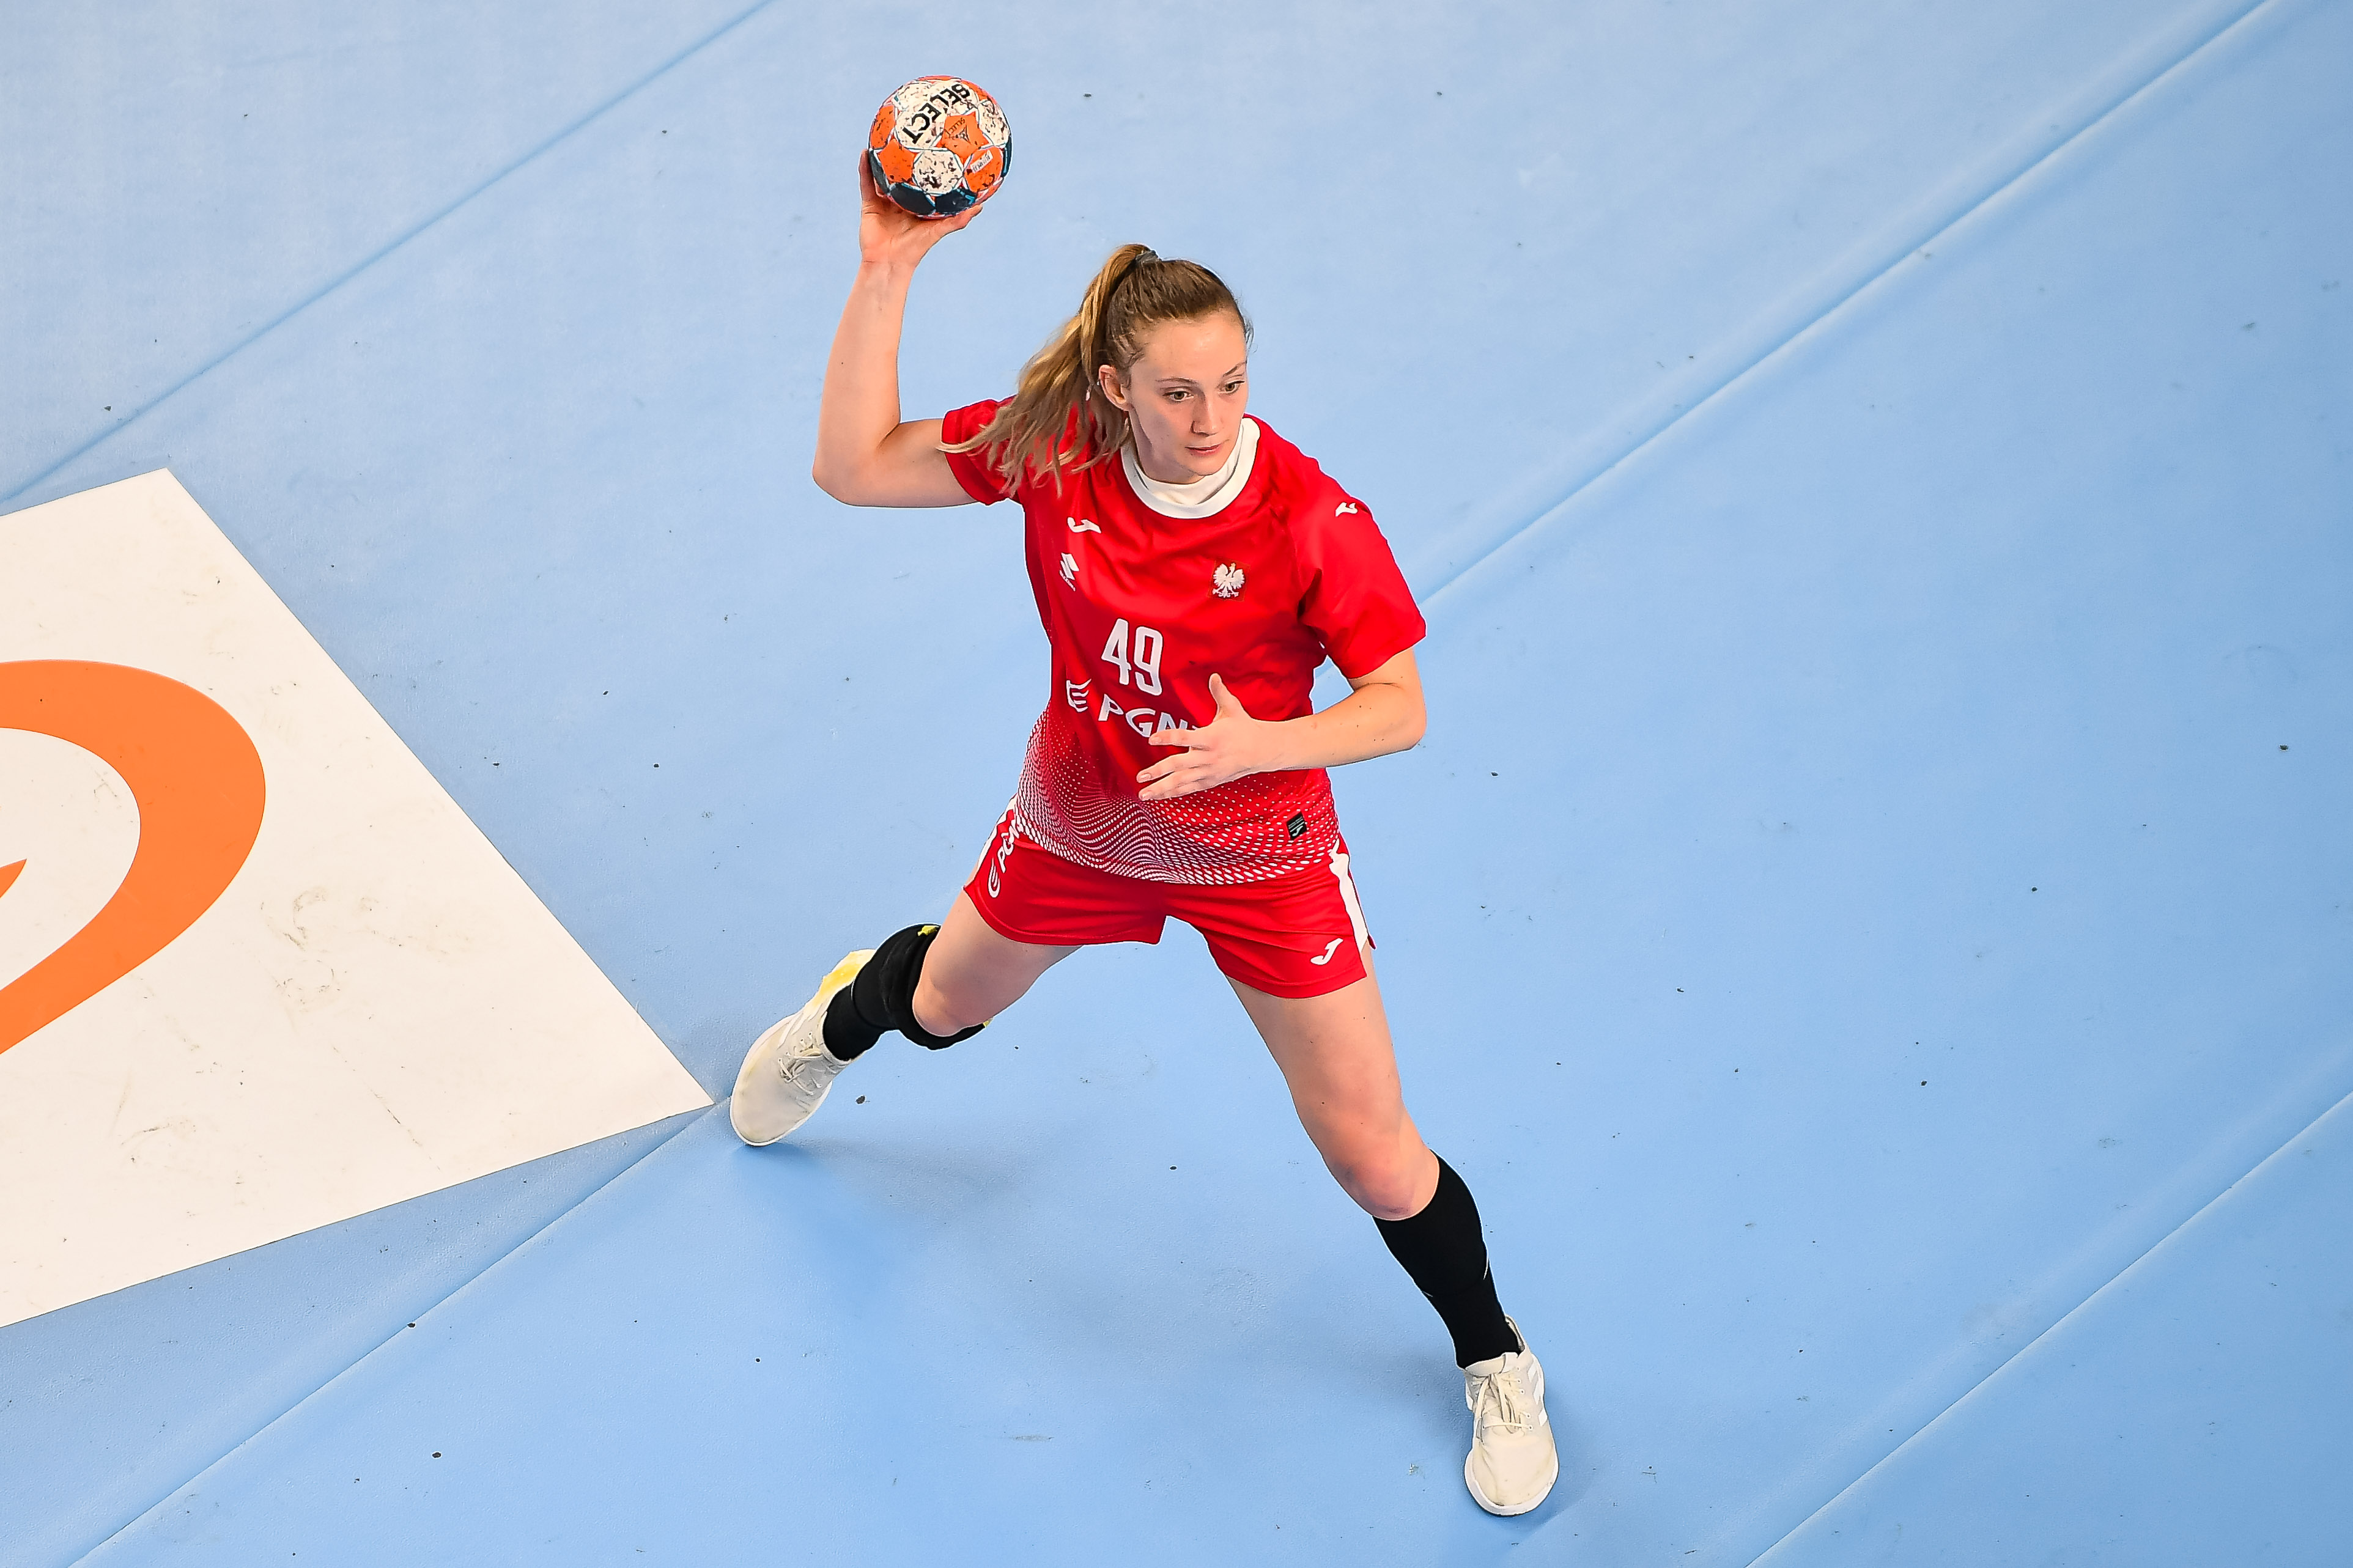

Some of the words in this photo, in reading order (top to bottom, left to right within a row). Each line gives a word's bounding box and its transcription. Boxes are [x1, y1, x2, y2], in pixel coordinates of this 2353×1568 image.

[902, 83, 970, 144] SELECT
[1101, 617, 1163, 696] 49
[1098, 693, 1198, 738] PGN
